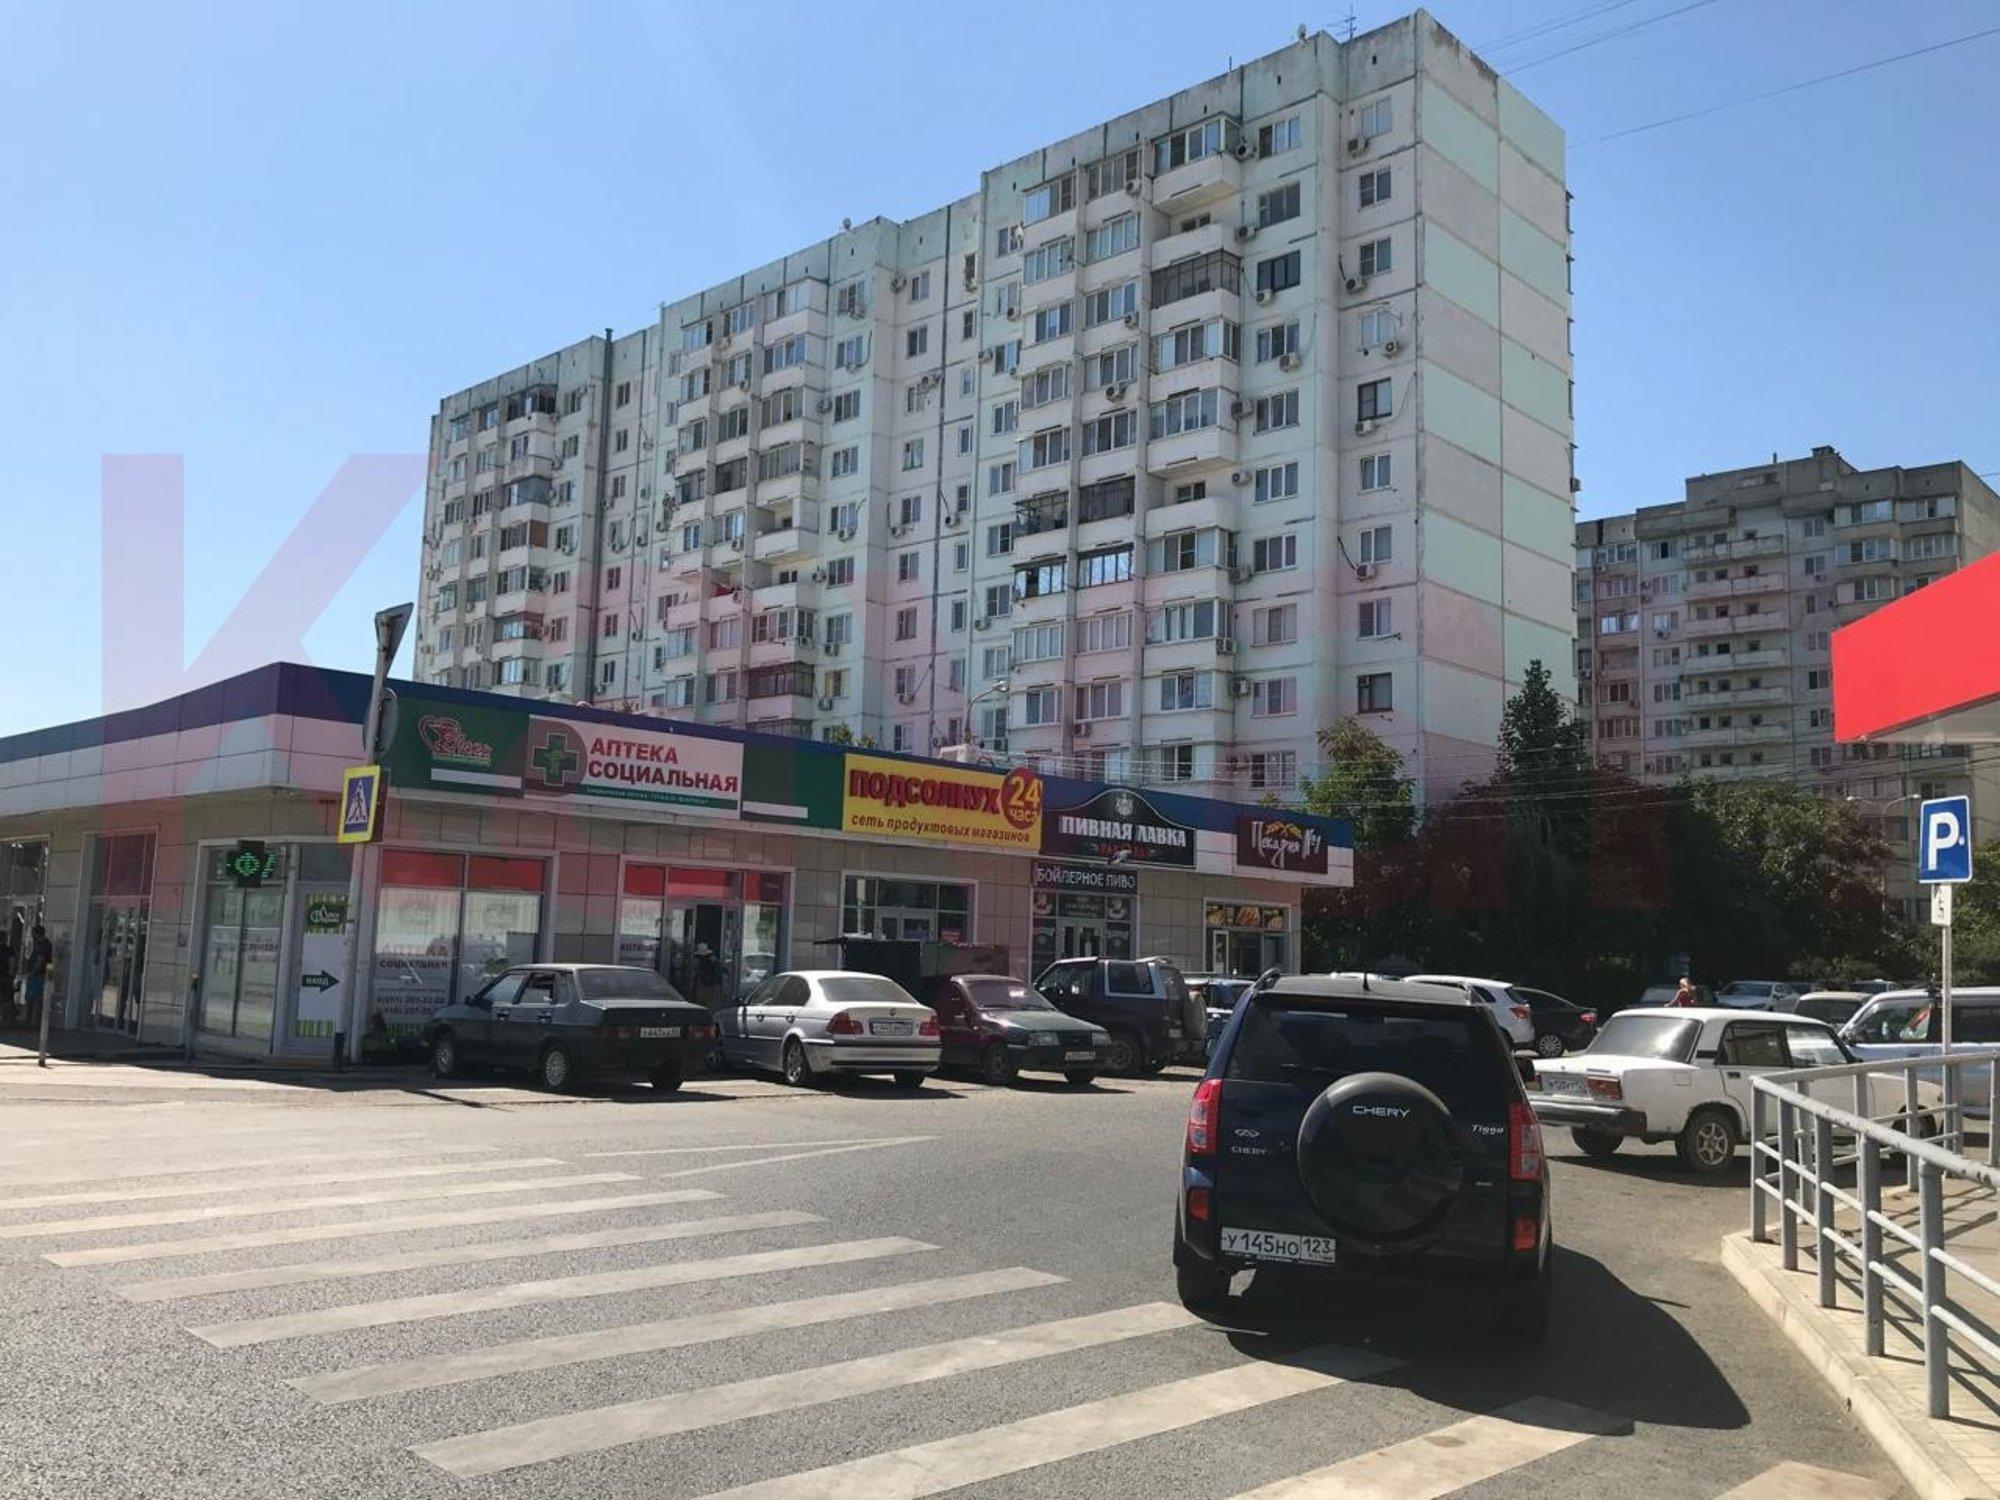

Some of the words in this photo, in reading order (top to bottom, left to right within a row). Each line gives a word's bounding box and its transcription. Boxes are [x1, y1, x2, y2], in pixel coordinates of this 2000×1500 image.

[590, 737, 678, 764] АПТЕКА
[588, 760, 738, 792] СОЦИАЛЬНАЯ
[1010, 776, 1040, 807] 24
[851, 813, 884, 827] сеть
[887, 816, 969, 837] продуктовых
[971, 827, 1030, 843] магазинов
[1059, 815, 1132, 840] ПИВНАЯ
[1136, 825, 1187, 847] ЛАВКА
[1928, 812, 1960, 870] P
[1037, 865, 1104, 887] БОЙЛЕРНОЕ
[1106, 874, 1136, 889] ПИВО
[1352, 1105, 1411, 1118] CHERY
[1231, 1145, 1267, 1155] CHERY
